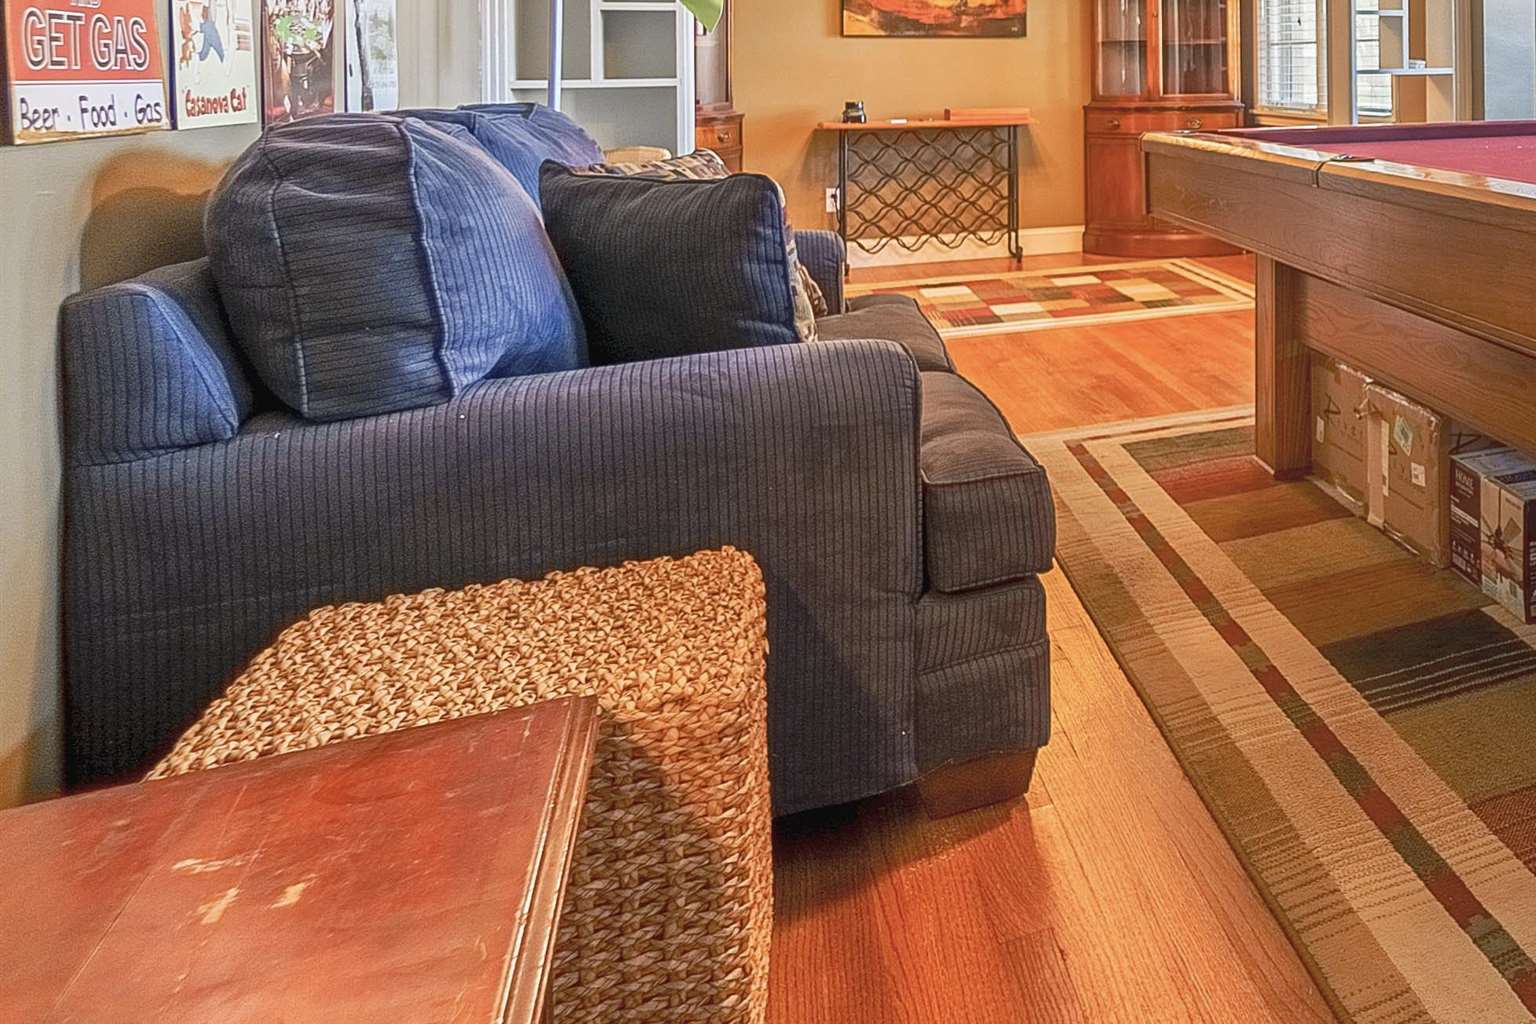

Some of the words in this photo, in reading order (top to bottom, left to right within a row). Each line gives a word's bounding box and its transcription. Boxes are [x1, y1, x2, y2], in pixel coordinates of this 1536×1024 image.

[22, 6, 86, 71] GET
[90, 13, 151, 72] GAS
[20, 96, 60, 131] Beer
[78, 93, 116, 130] Food
[134, 93, 163, 125] Gas
